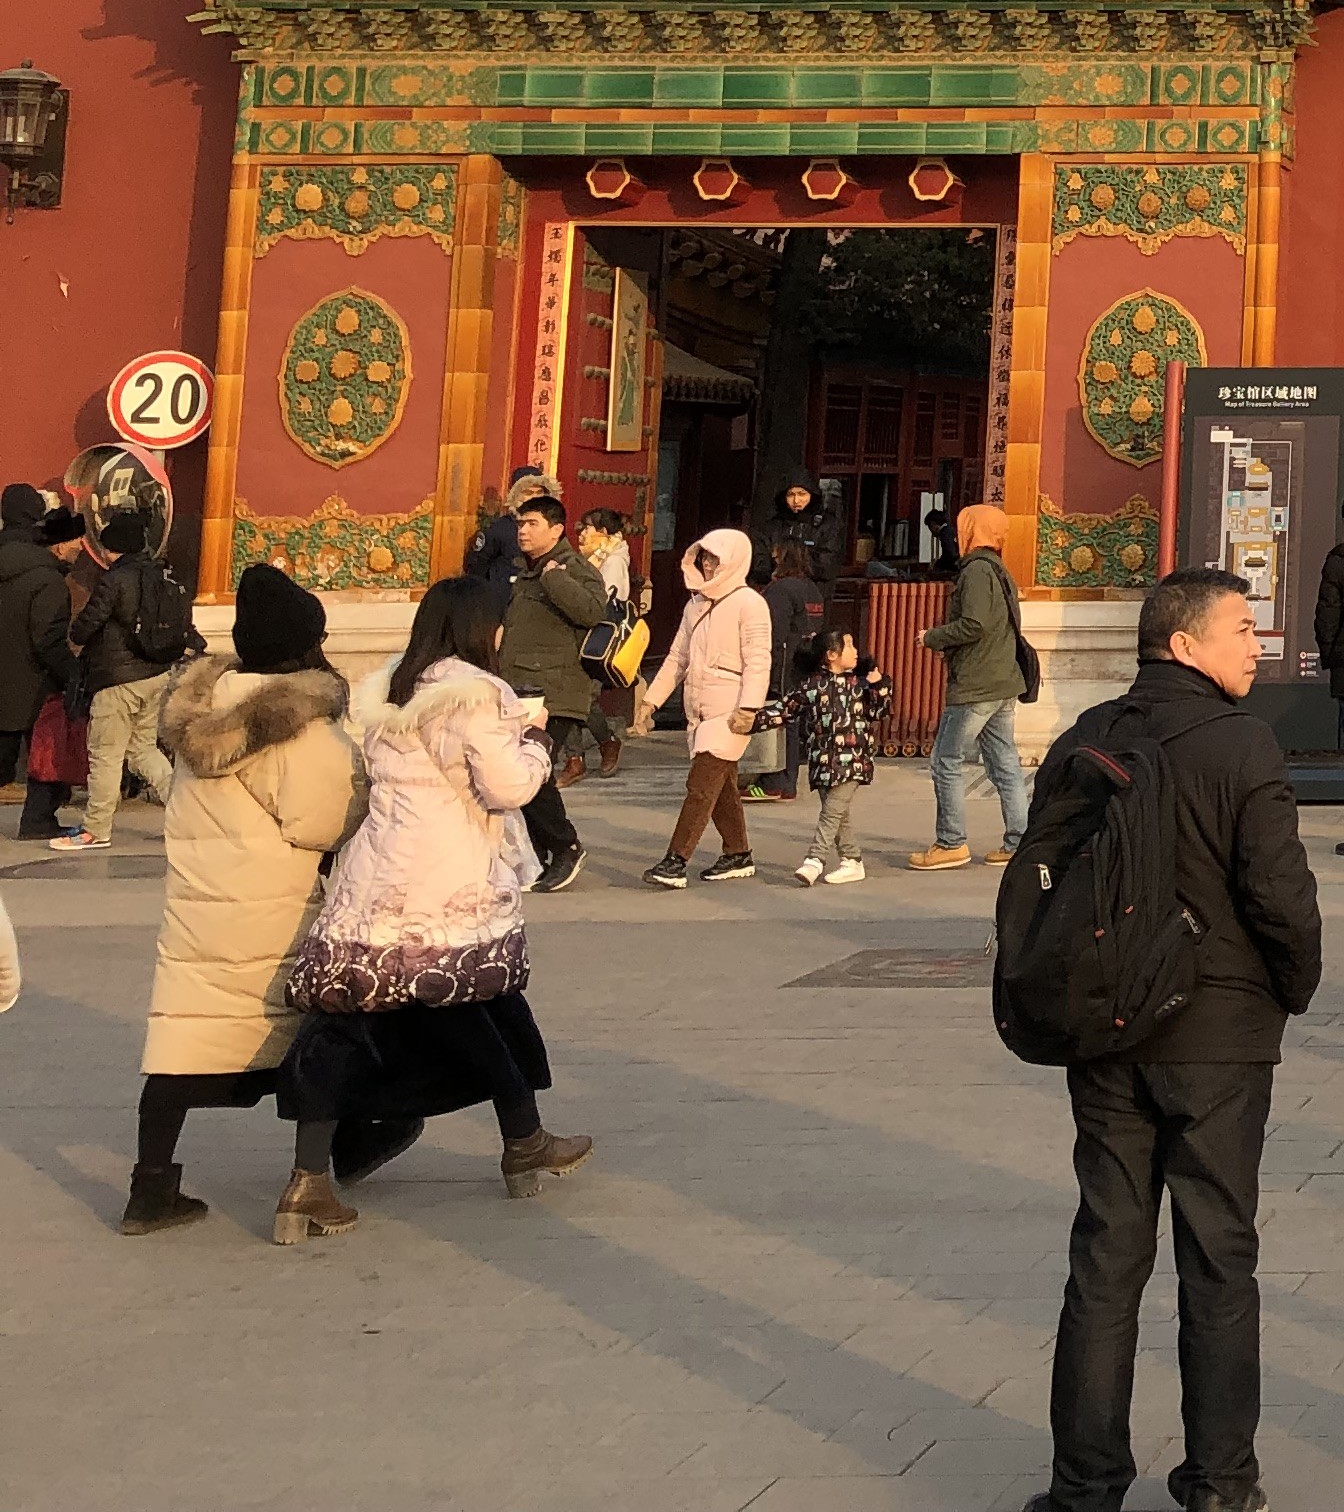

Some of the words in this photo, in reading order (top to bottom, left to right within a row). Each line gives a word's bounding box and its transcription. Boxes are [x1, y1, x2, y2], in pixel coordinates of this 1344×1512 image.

[130, 373, 200, 425] 20
[1218, 385, 1317, 400] 珍宝馆区域地图
